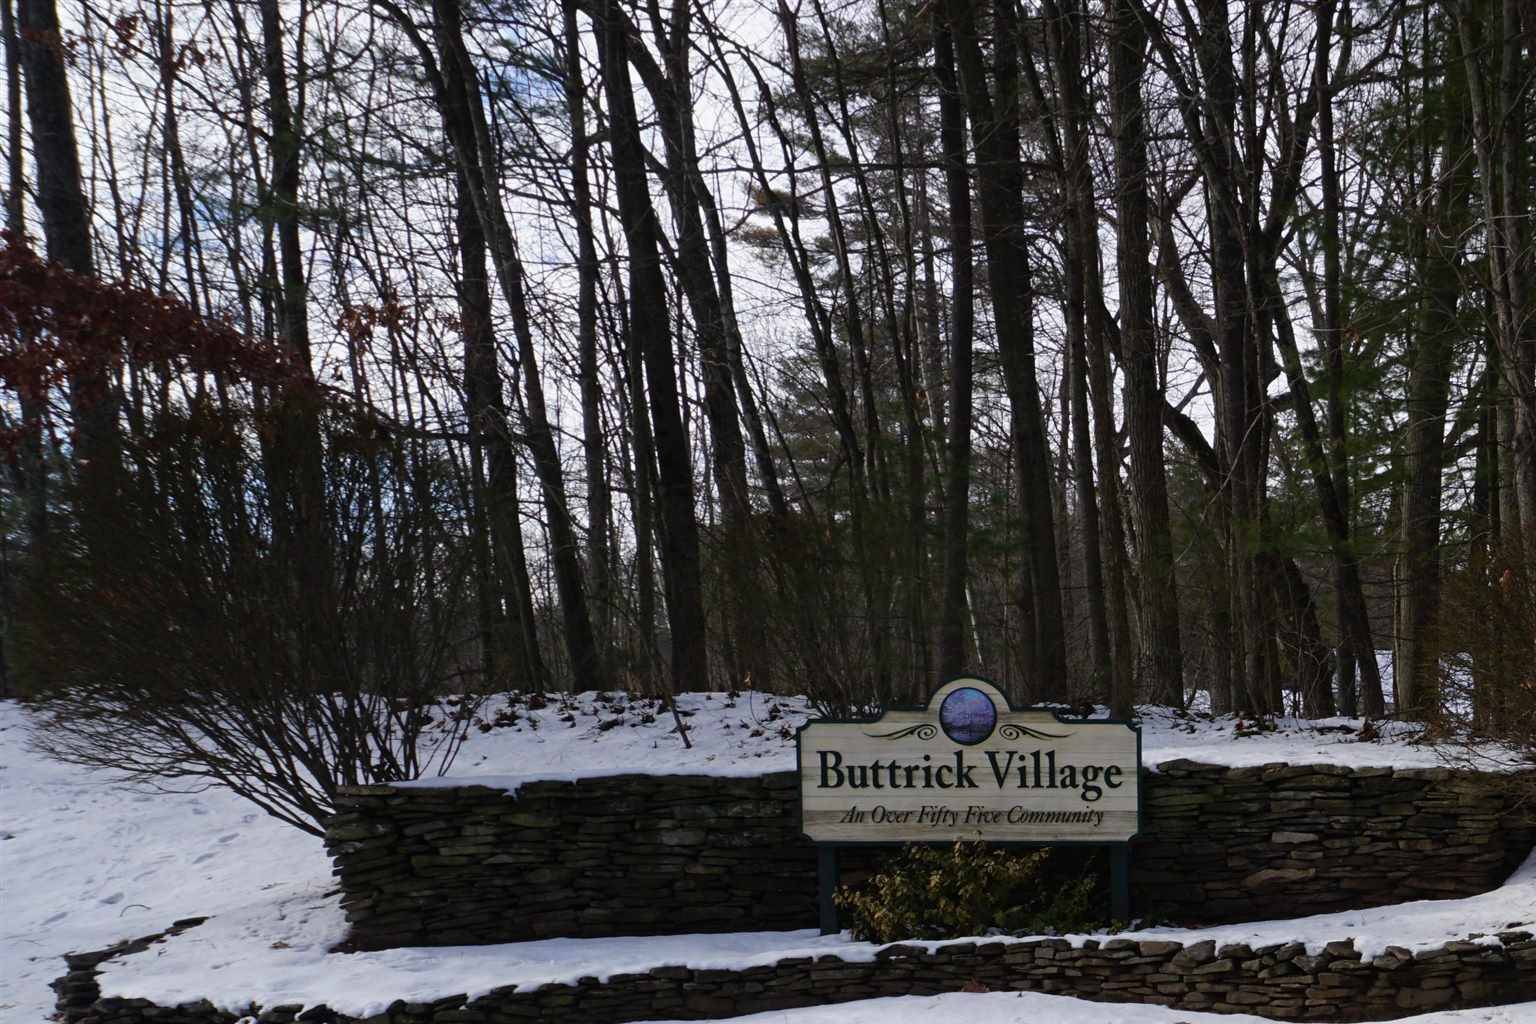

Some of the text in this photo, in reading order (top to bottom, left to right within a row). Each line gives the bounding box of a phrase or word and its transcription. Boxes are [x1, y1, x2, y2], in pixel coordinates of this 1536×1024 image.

[816, 750, 1124, 801] Buttrick Village
[841, 805, 1104, 827] An Over Fifty Five Community
